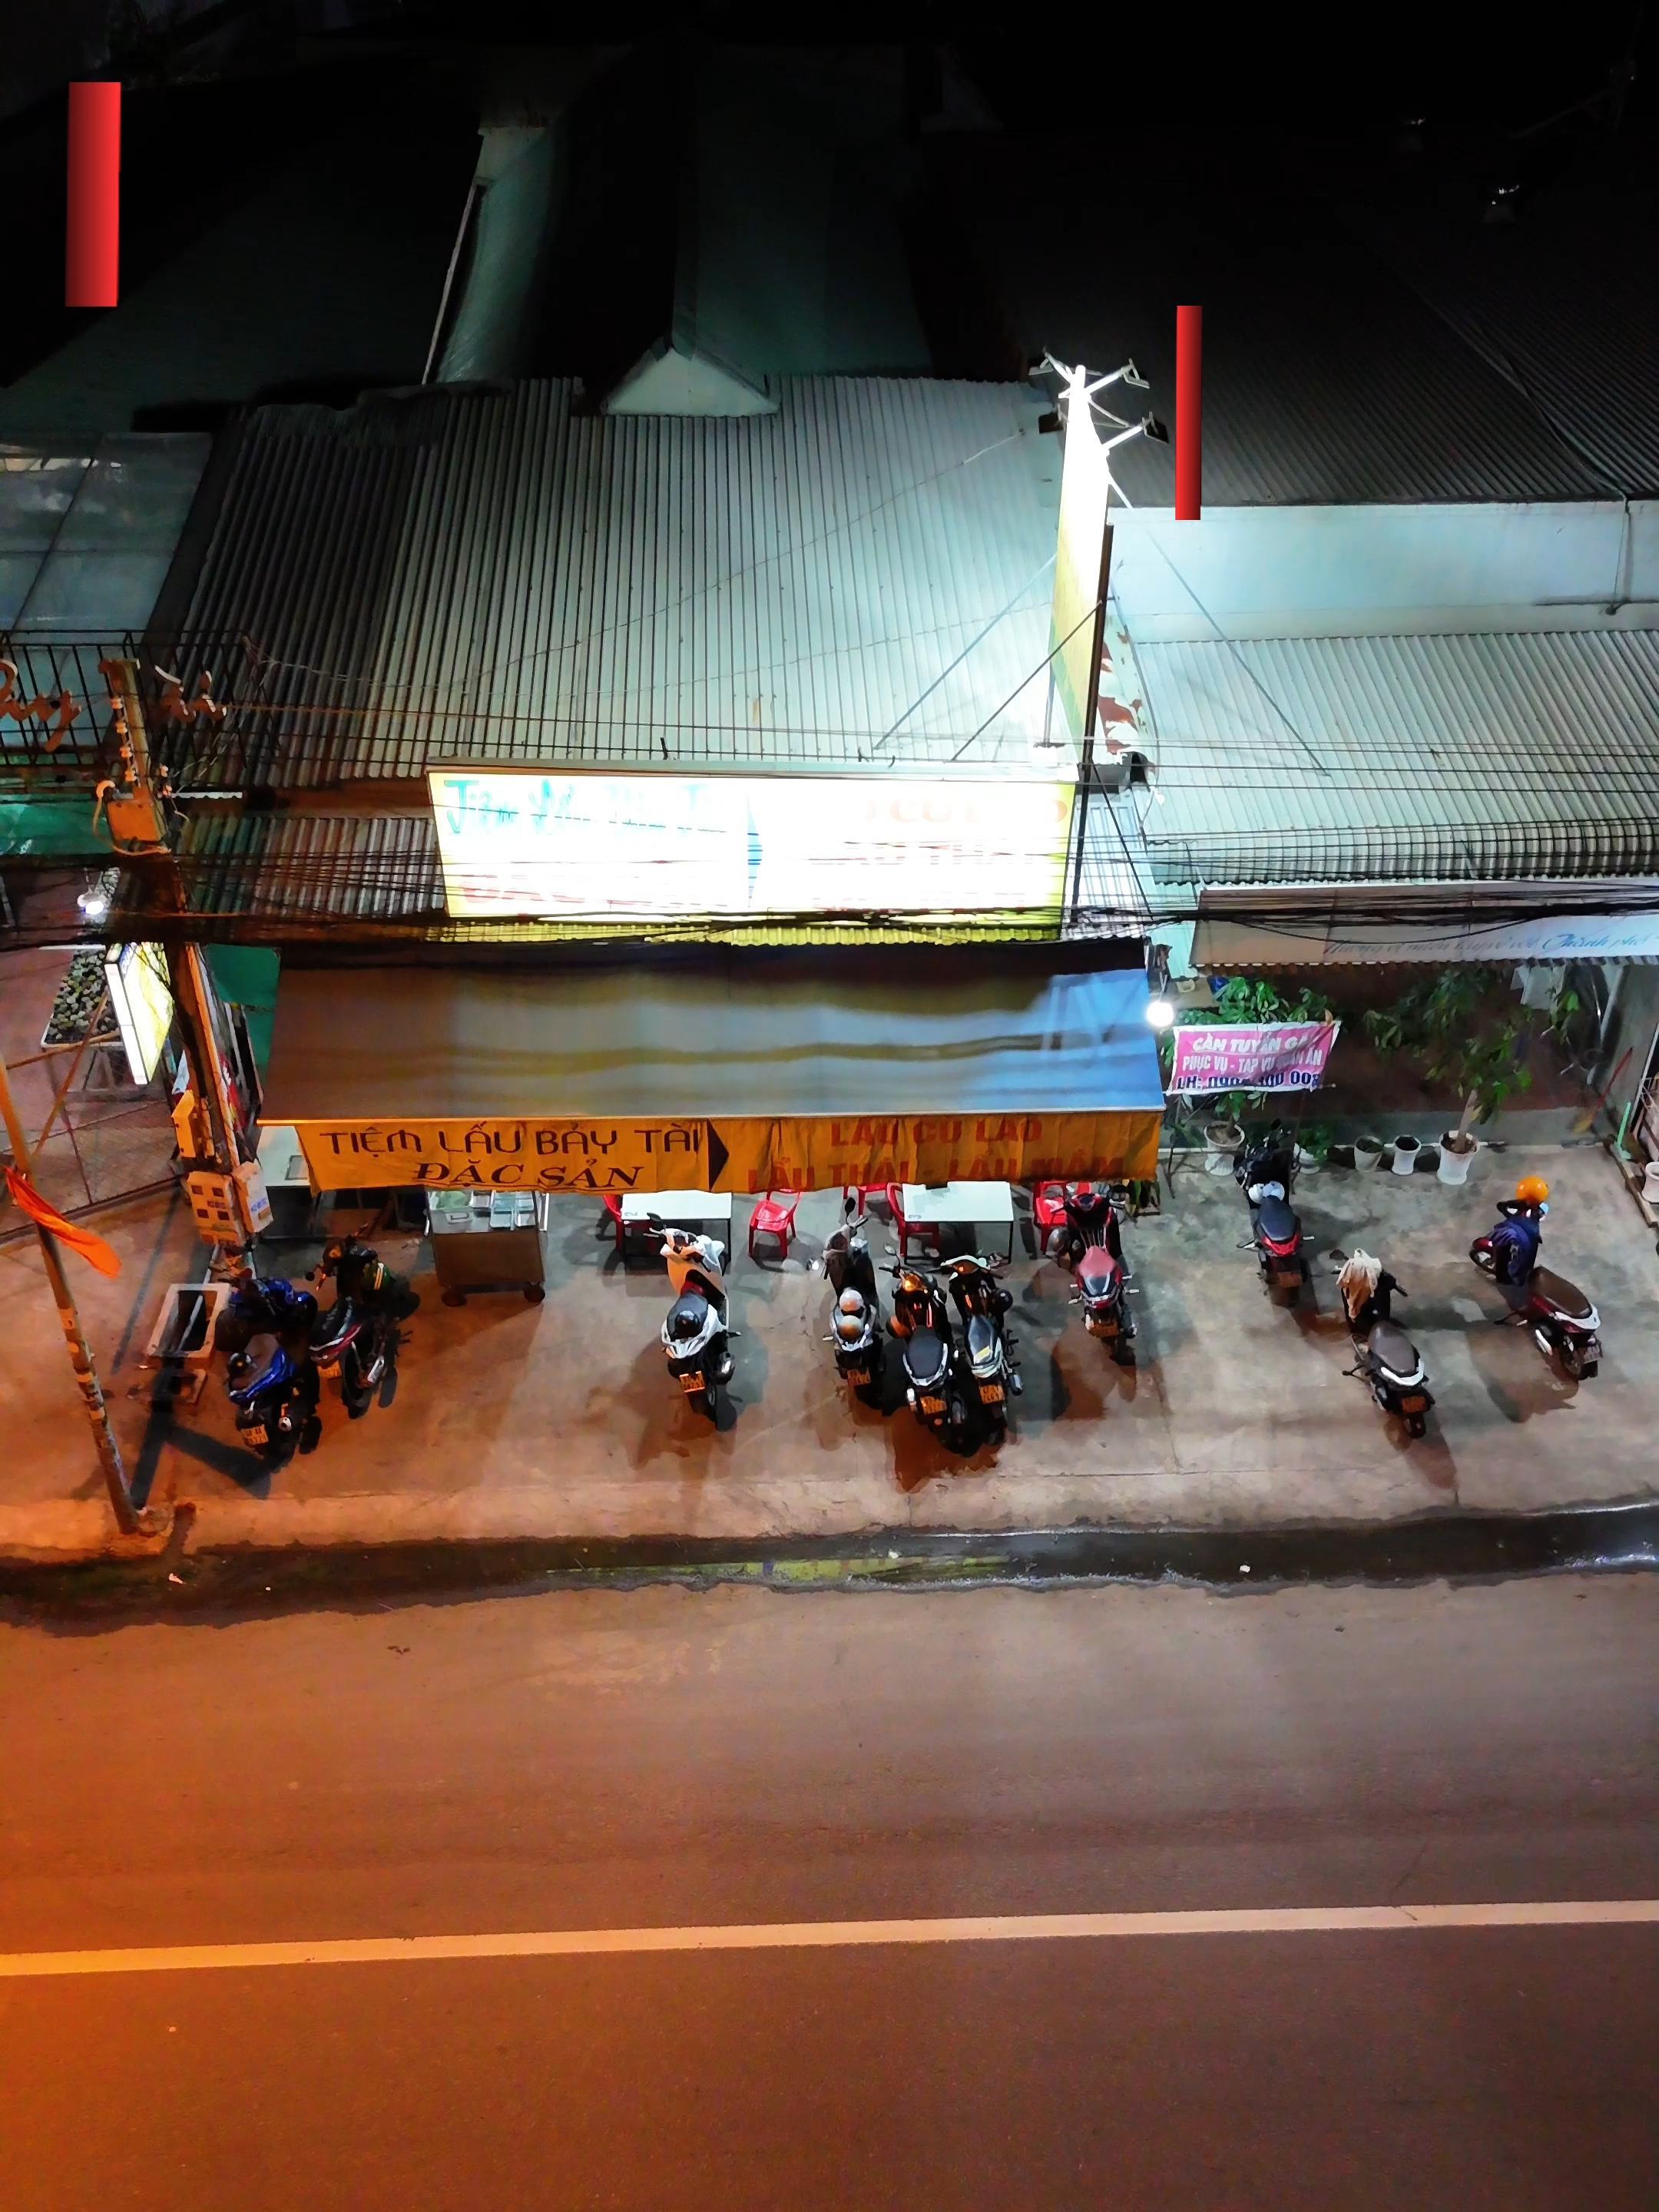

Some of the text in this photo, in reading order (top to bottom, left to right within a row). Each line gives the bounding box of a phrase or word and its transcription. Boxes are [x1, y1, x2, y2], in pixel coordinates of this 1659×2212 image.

[320, 1127, 422, 1157] TIỆM
[536, 1123, 618, 1155] BẢY
[634, 1123, 699, 1154] TÀI
[412, 1159, 644, 1188] ĐẶC SẢN
